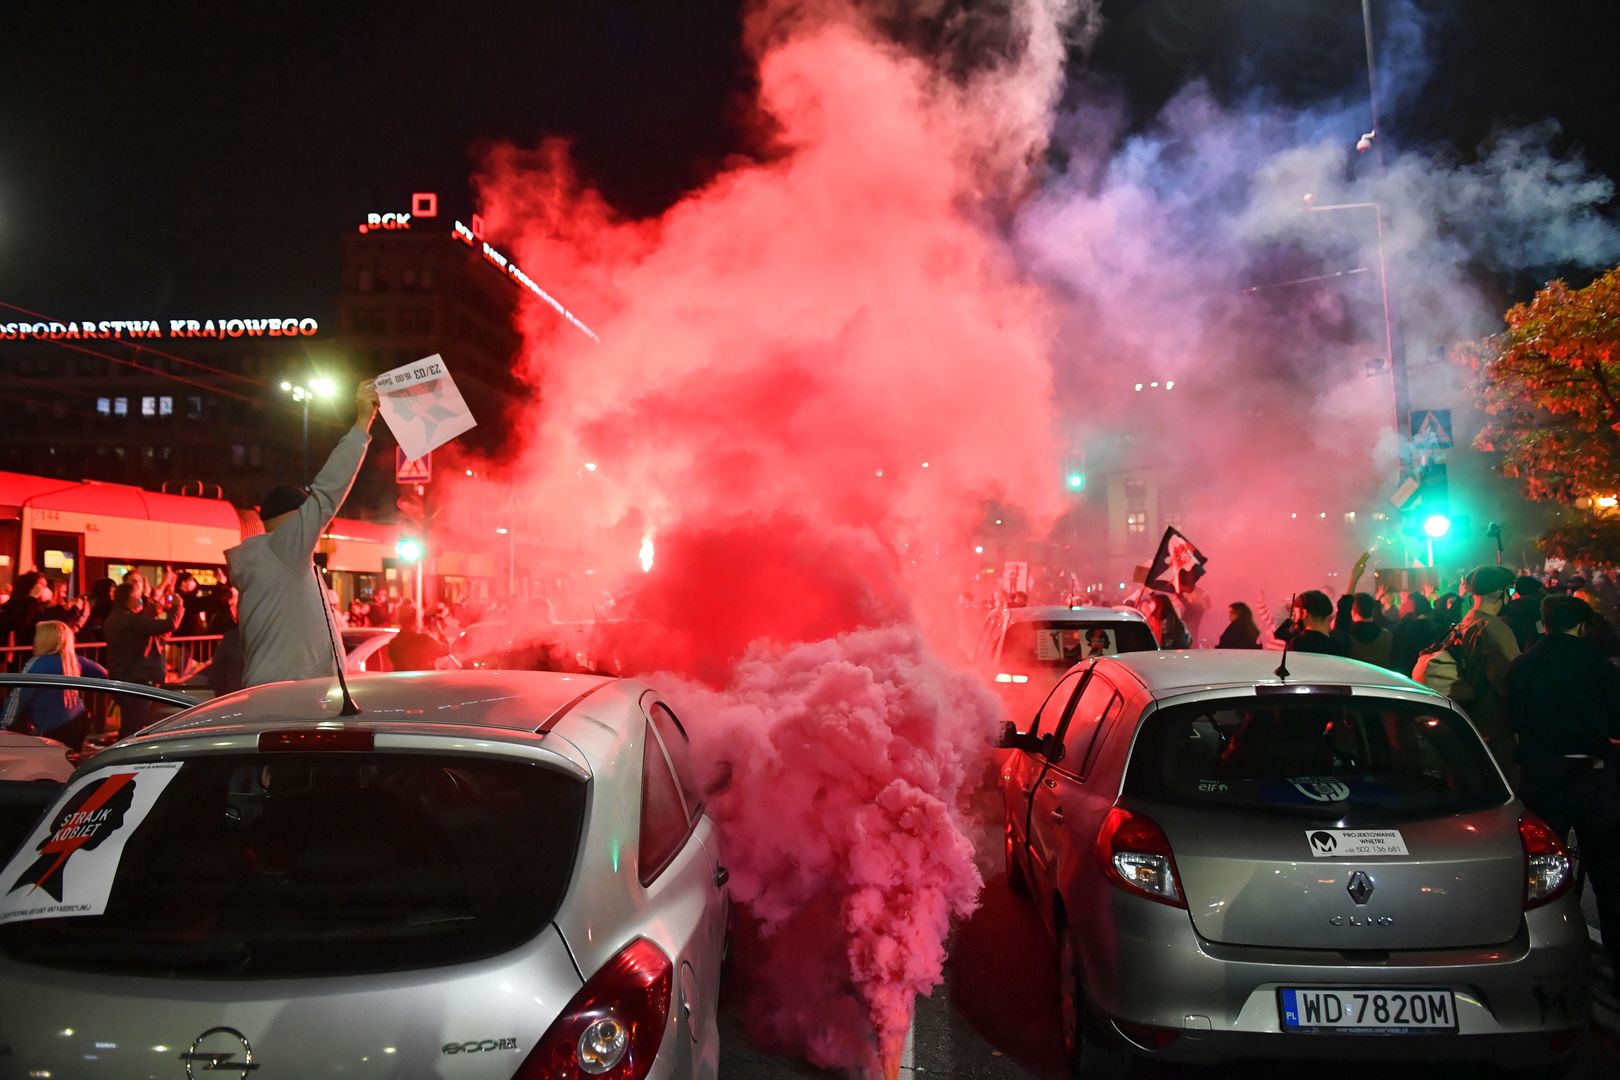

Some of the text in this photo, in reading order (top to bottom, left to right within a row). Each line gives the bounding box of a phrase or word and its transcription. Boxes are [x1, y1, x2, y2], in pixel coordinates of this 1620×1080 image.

[368, 213, 411, 231] BGK
[169, 318, 319, 340] KRAJOWEGO
[413, 363, 442, 380] 23/03
[60, 808, 113, 827] STRAJK
[51, 823, 102, 842] KOBIET
[1329, 915, 1394, 926] CLIO
[1286, 993, 1449, 1024] PL WD 7820M
